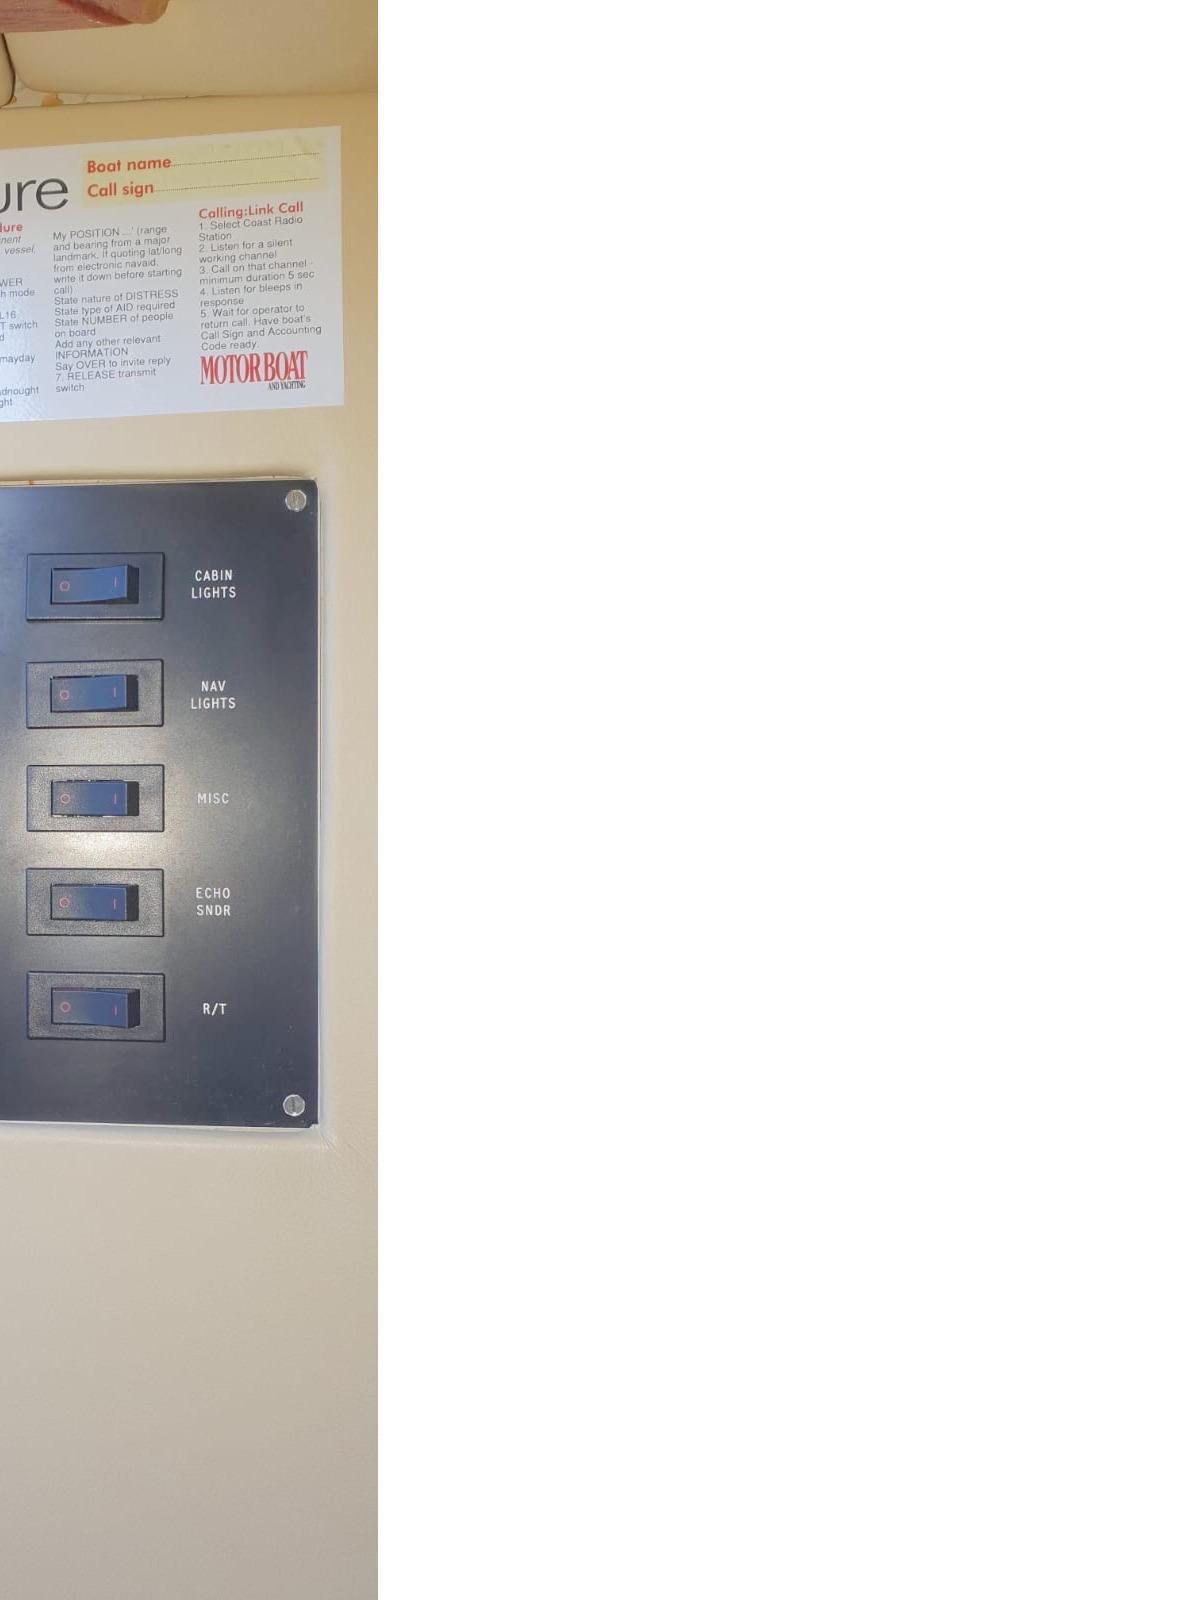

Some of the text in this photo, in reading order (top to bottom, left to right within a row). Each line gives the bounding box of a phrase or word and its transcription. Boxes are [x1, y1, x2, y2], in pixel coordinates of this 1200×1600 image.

[87, 157, 172, 174] Boat name
[87, 181, 154, 199] Call sign
[278, 201, 304, 214] Call
[210, 215, 303, 231] Select Coast Radio
[53, 227, 120, 242] My POSITION
[199, 232, 232, 242] Station
[53, 236, 170, 252] and bearing from major
[210, 238, 293, 252] Listen for silent
[110, 245, 182, 258] quoting lat/long
[199, 250, 277, 264] working channel
[53, 260, 123, 273] from electronic
[211, 258, 307, 274] Call that channel
[54, 268, 183, 284] write down before starting
[200, 271, 315, 285] minimum duration sec
[9, 288, 36, 298] mode
[54, 285, 73, 296] call)
[212, 282, 291, 296] Listen for bleeps
[54, 288, 179, 306] State nature DISTRESS
[200, 297, 244, 308] response
[54, 300, 175, 317] State type AID required
[212, 304, 293, 318] Wait for operator
[8, 320, 38, 331] switch
[54, 311, 174, 327] State NUMBER people
[200, 314, 311, 330] return Have boat's
[69, 328, 96, 338] board
[200, 325, 322, 341] Call Sign and Accounting
[55, 334, 161, 349] Add any other relevant
[201, 341, 227, 351] Code
[0, 352, 36, 364] mayday
[55, 347, 129, 360] INFORMATION
[55, 356, 171, 372] Say OVER invite reply
[200, 350, 309, 385] MOTOR BOAT
[67, 367, 157, 381] RELEASE transmit
[55, 383, 85, 393] switch
[194, 569, 233, 582] CABIN
[191, 586, 237, 599] LIGHTS
[201, 680, 226, 692] NAV
[190, 697, 236, 710] LIGHTS
[197, 792, 229, 805] MISC
[195, 887, 231, 899] ECHO
[196, 904, 231, 916] SNDR
[202, 1002, 227, 1016] R/T
